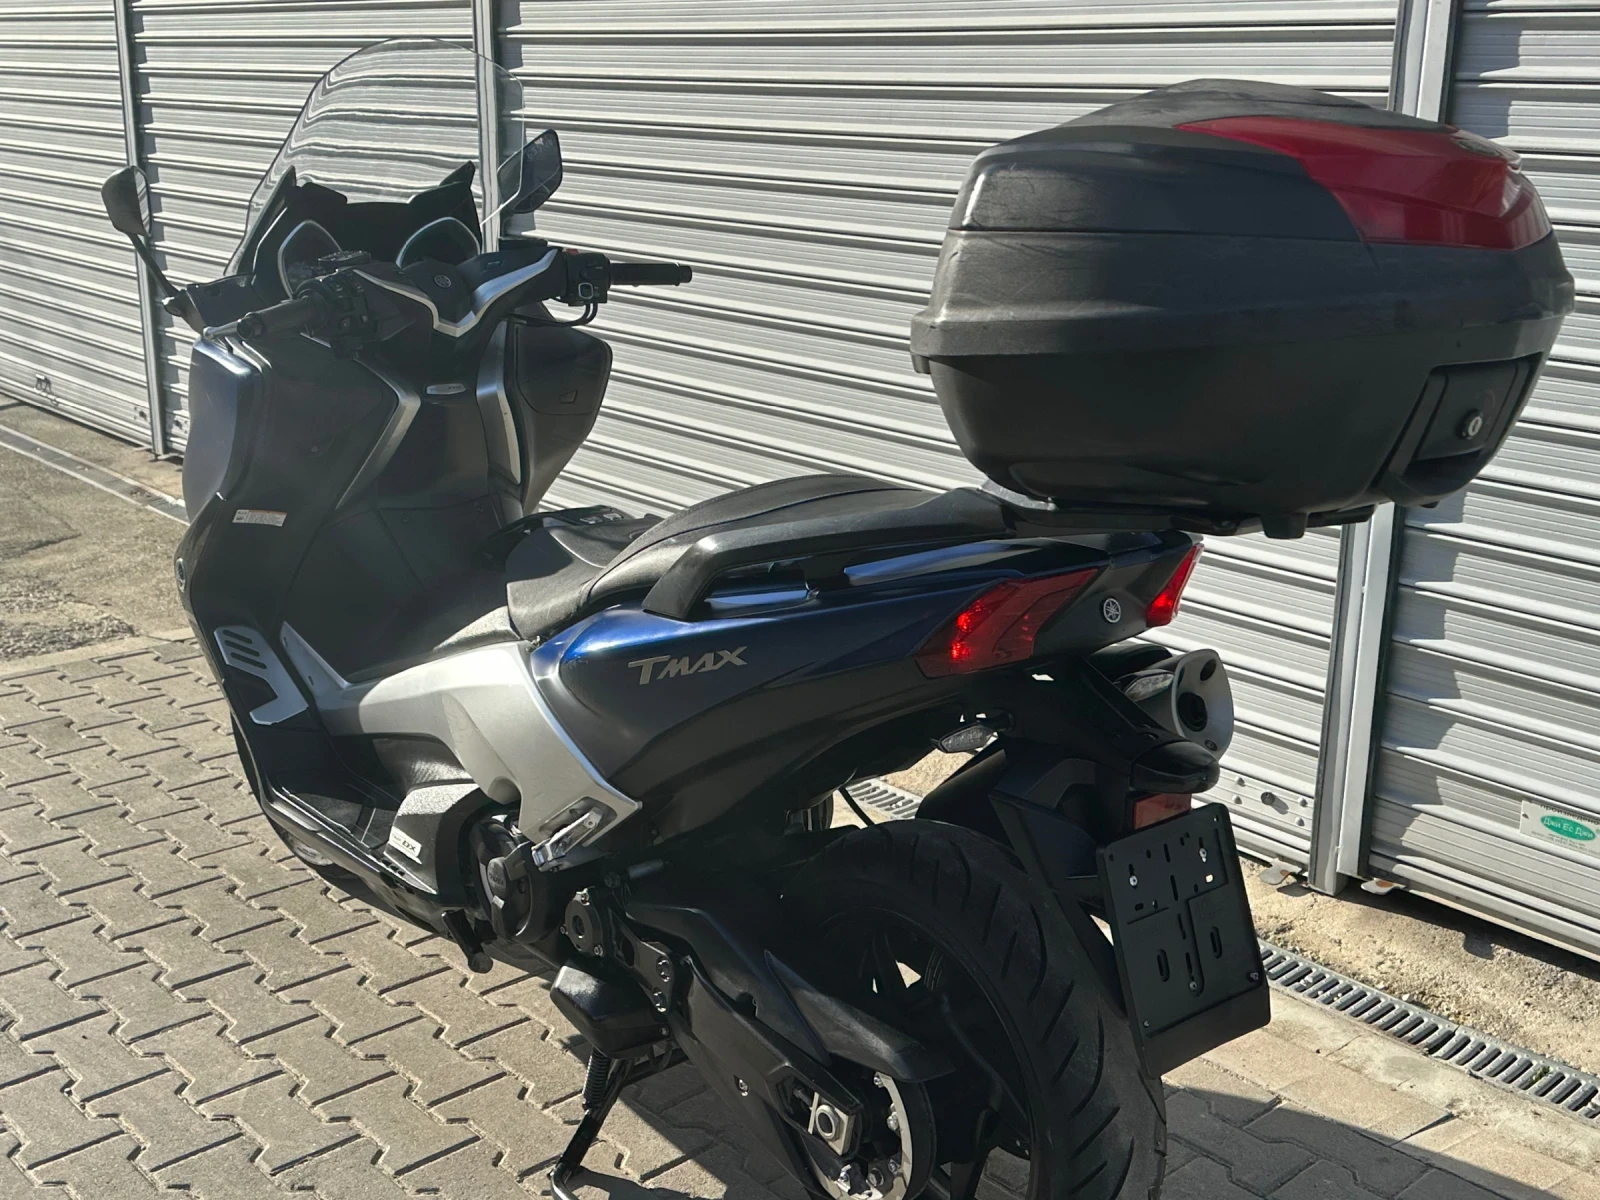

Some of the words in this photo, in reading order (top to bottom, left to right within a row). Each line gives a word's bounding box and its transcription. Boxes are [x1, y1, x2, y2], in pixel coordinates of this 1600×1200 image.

[628, 646, 748, 685] TMAX
[1543, 817, 1561, 829] Джи
[1575, 827, 1593, 839] Джи
